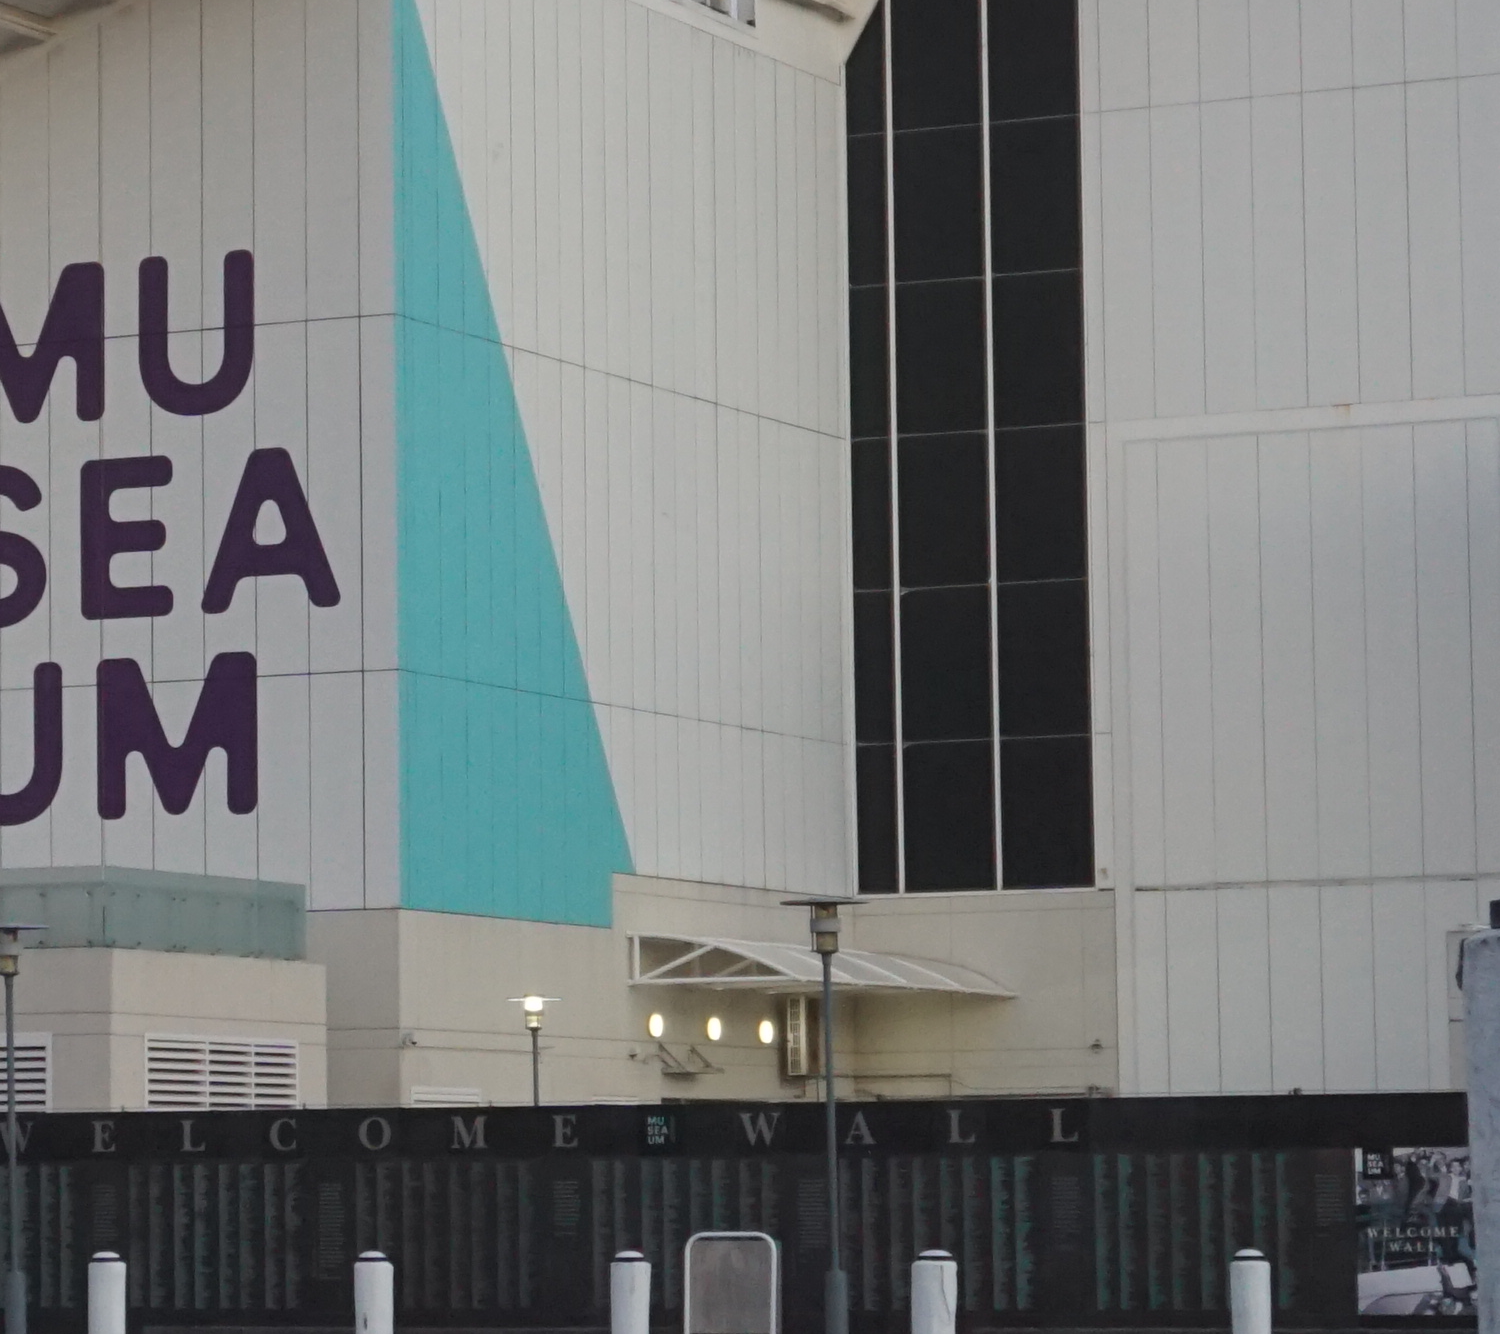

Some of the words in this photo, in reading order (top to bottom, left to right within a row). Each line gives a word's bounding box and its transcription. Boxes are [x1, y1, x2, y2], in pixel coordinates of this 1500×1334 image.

[647, 1116, 665, 1125] MU
[647, 1125, 669, 1135] SEA
[740, 1108, 1079, 1146] WALL
[647, 1135, 665, 1145] UM
[1367, 1153, 1381, 1161] MU
[1366, 1226, 1460, 1238] WELCOME
[1389, 1241, 1436, 1253] WALL
